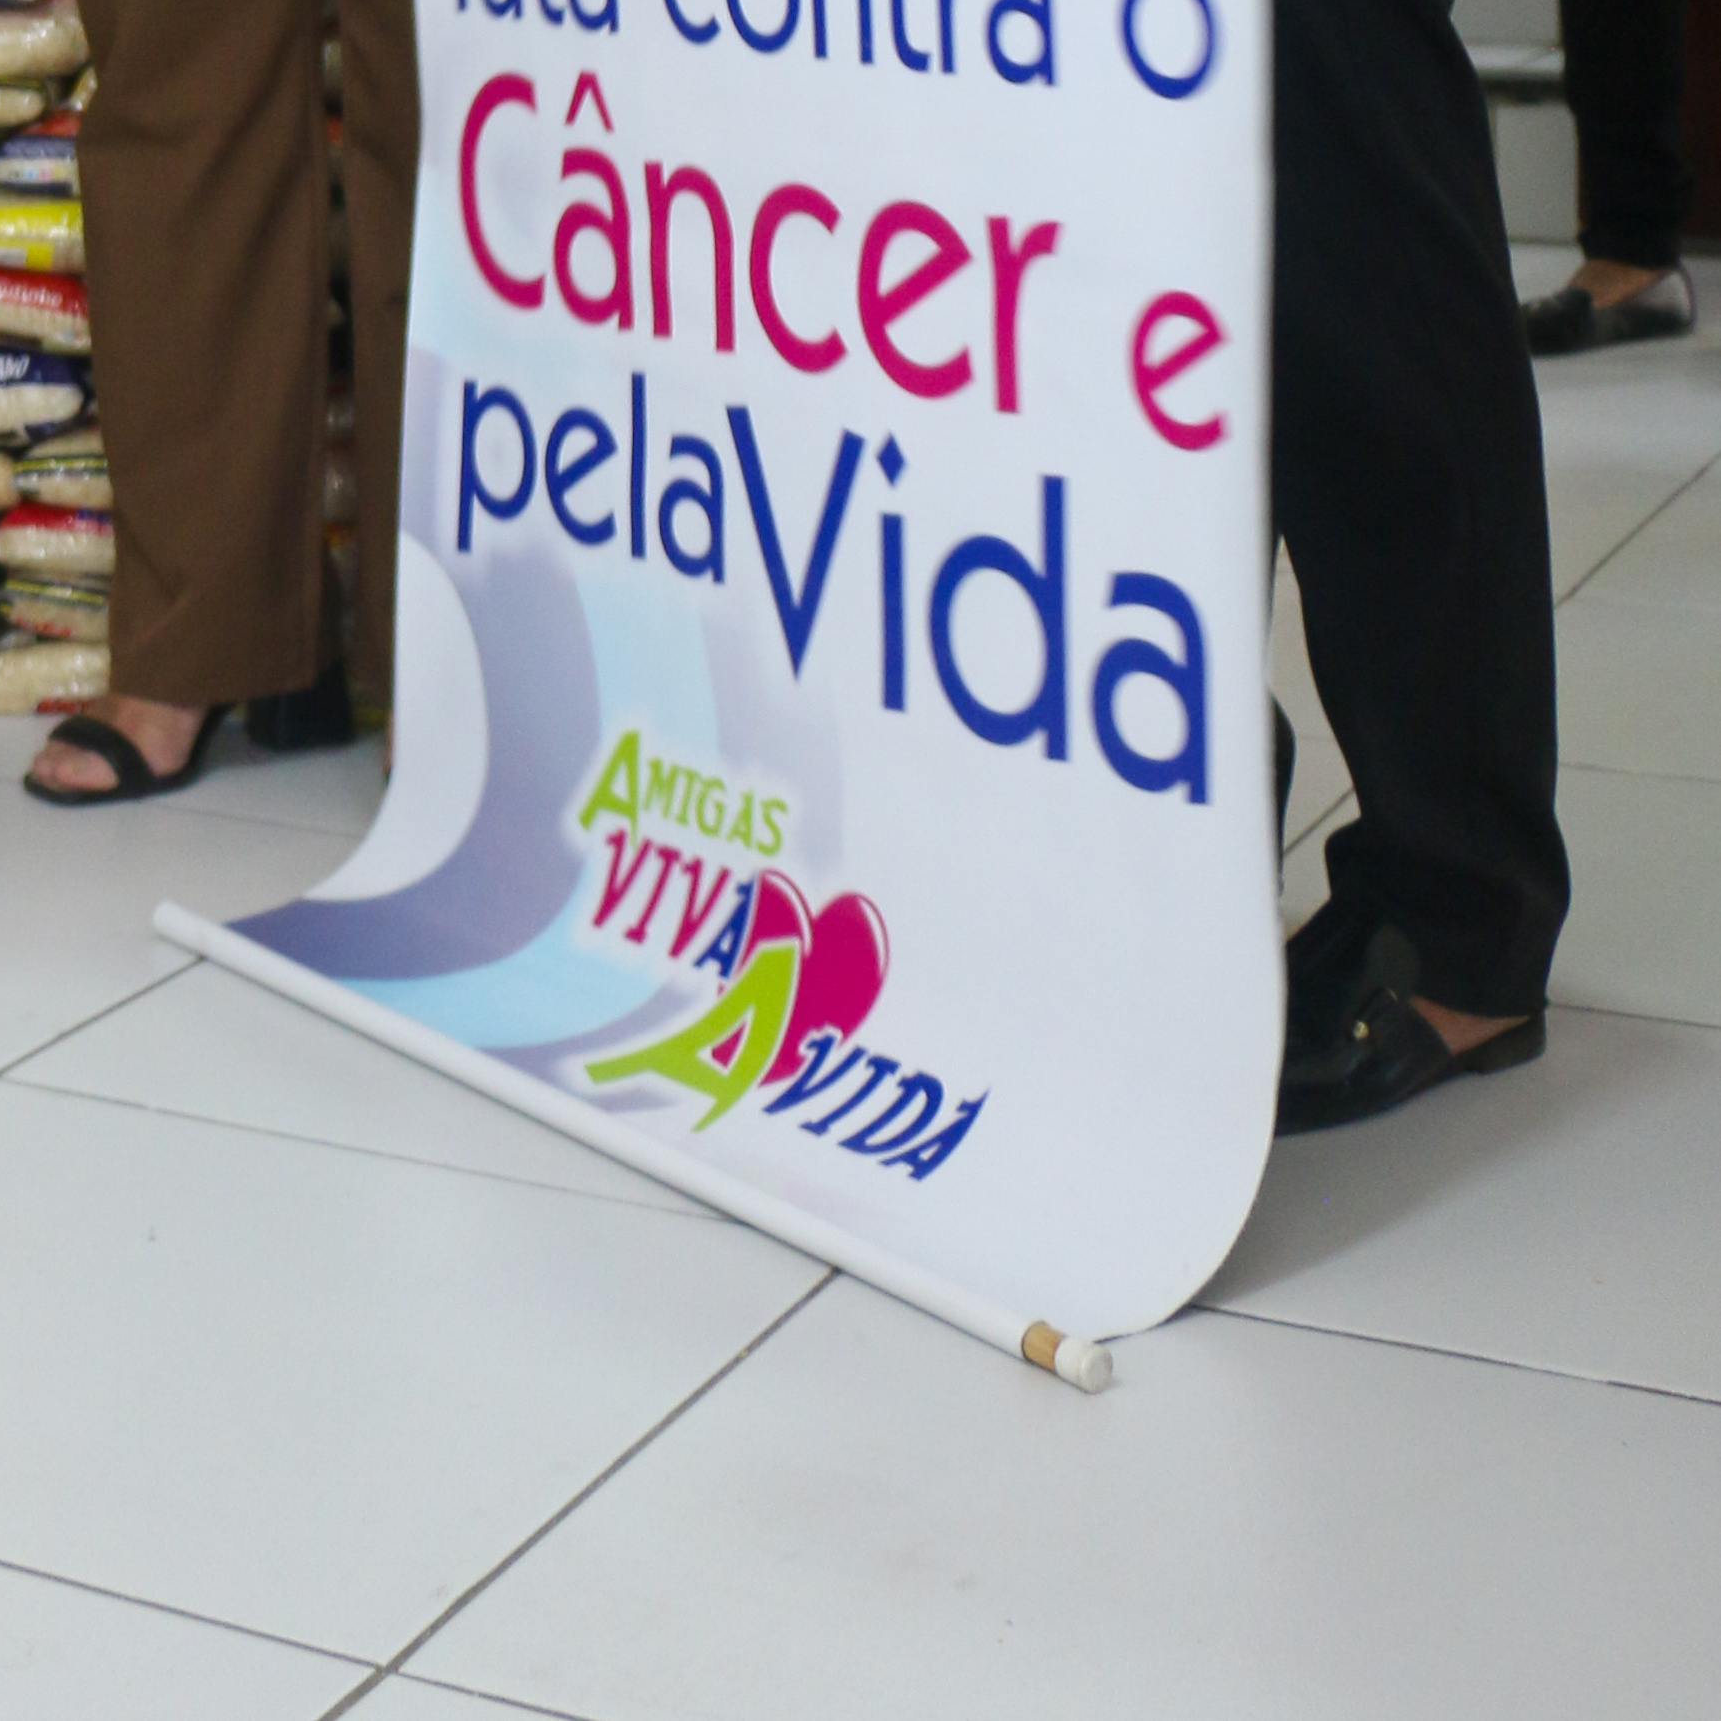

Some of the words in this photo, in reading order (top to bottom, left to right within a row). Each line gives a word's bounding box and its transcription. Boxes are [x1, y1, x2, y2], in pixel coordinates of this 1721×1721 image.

[458, 70, 1063, 416] Câncer
[1128, 289, 1231, 453] e
[578, 729, 788, 856] AMIGAS
[591, 827, 755, 980] VIVA
[583, 940, 800, 1133] A
[761, 1032, 991, 1182] VIDA
